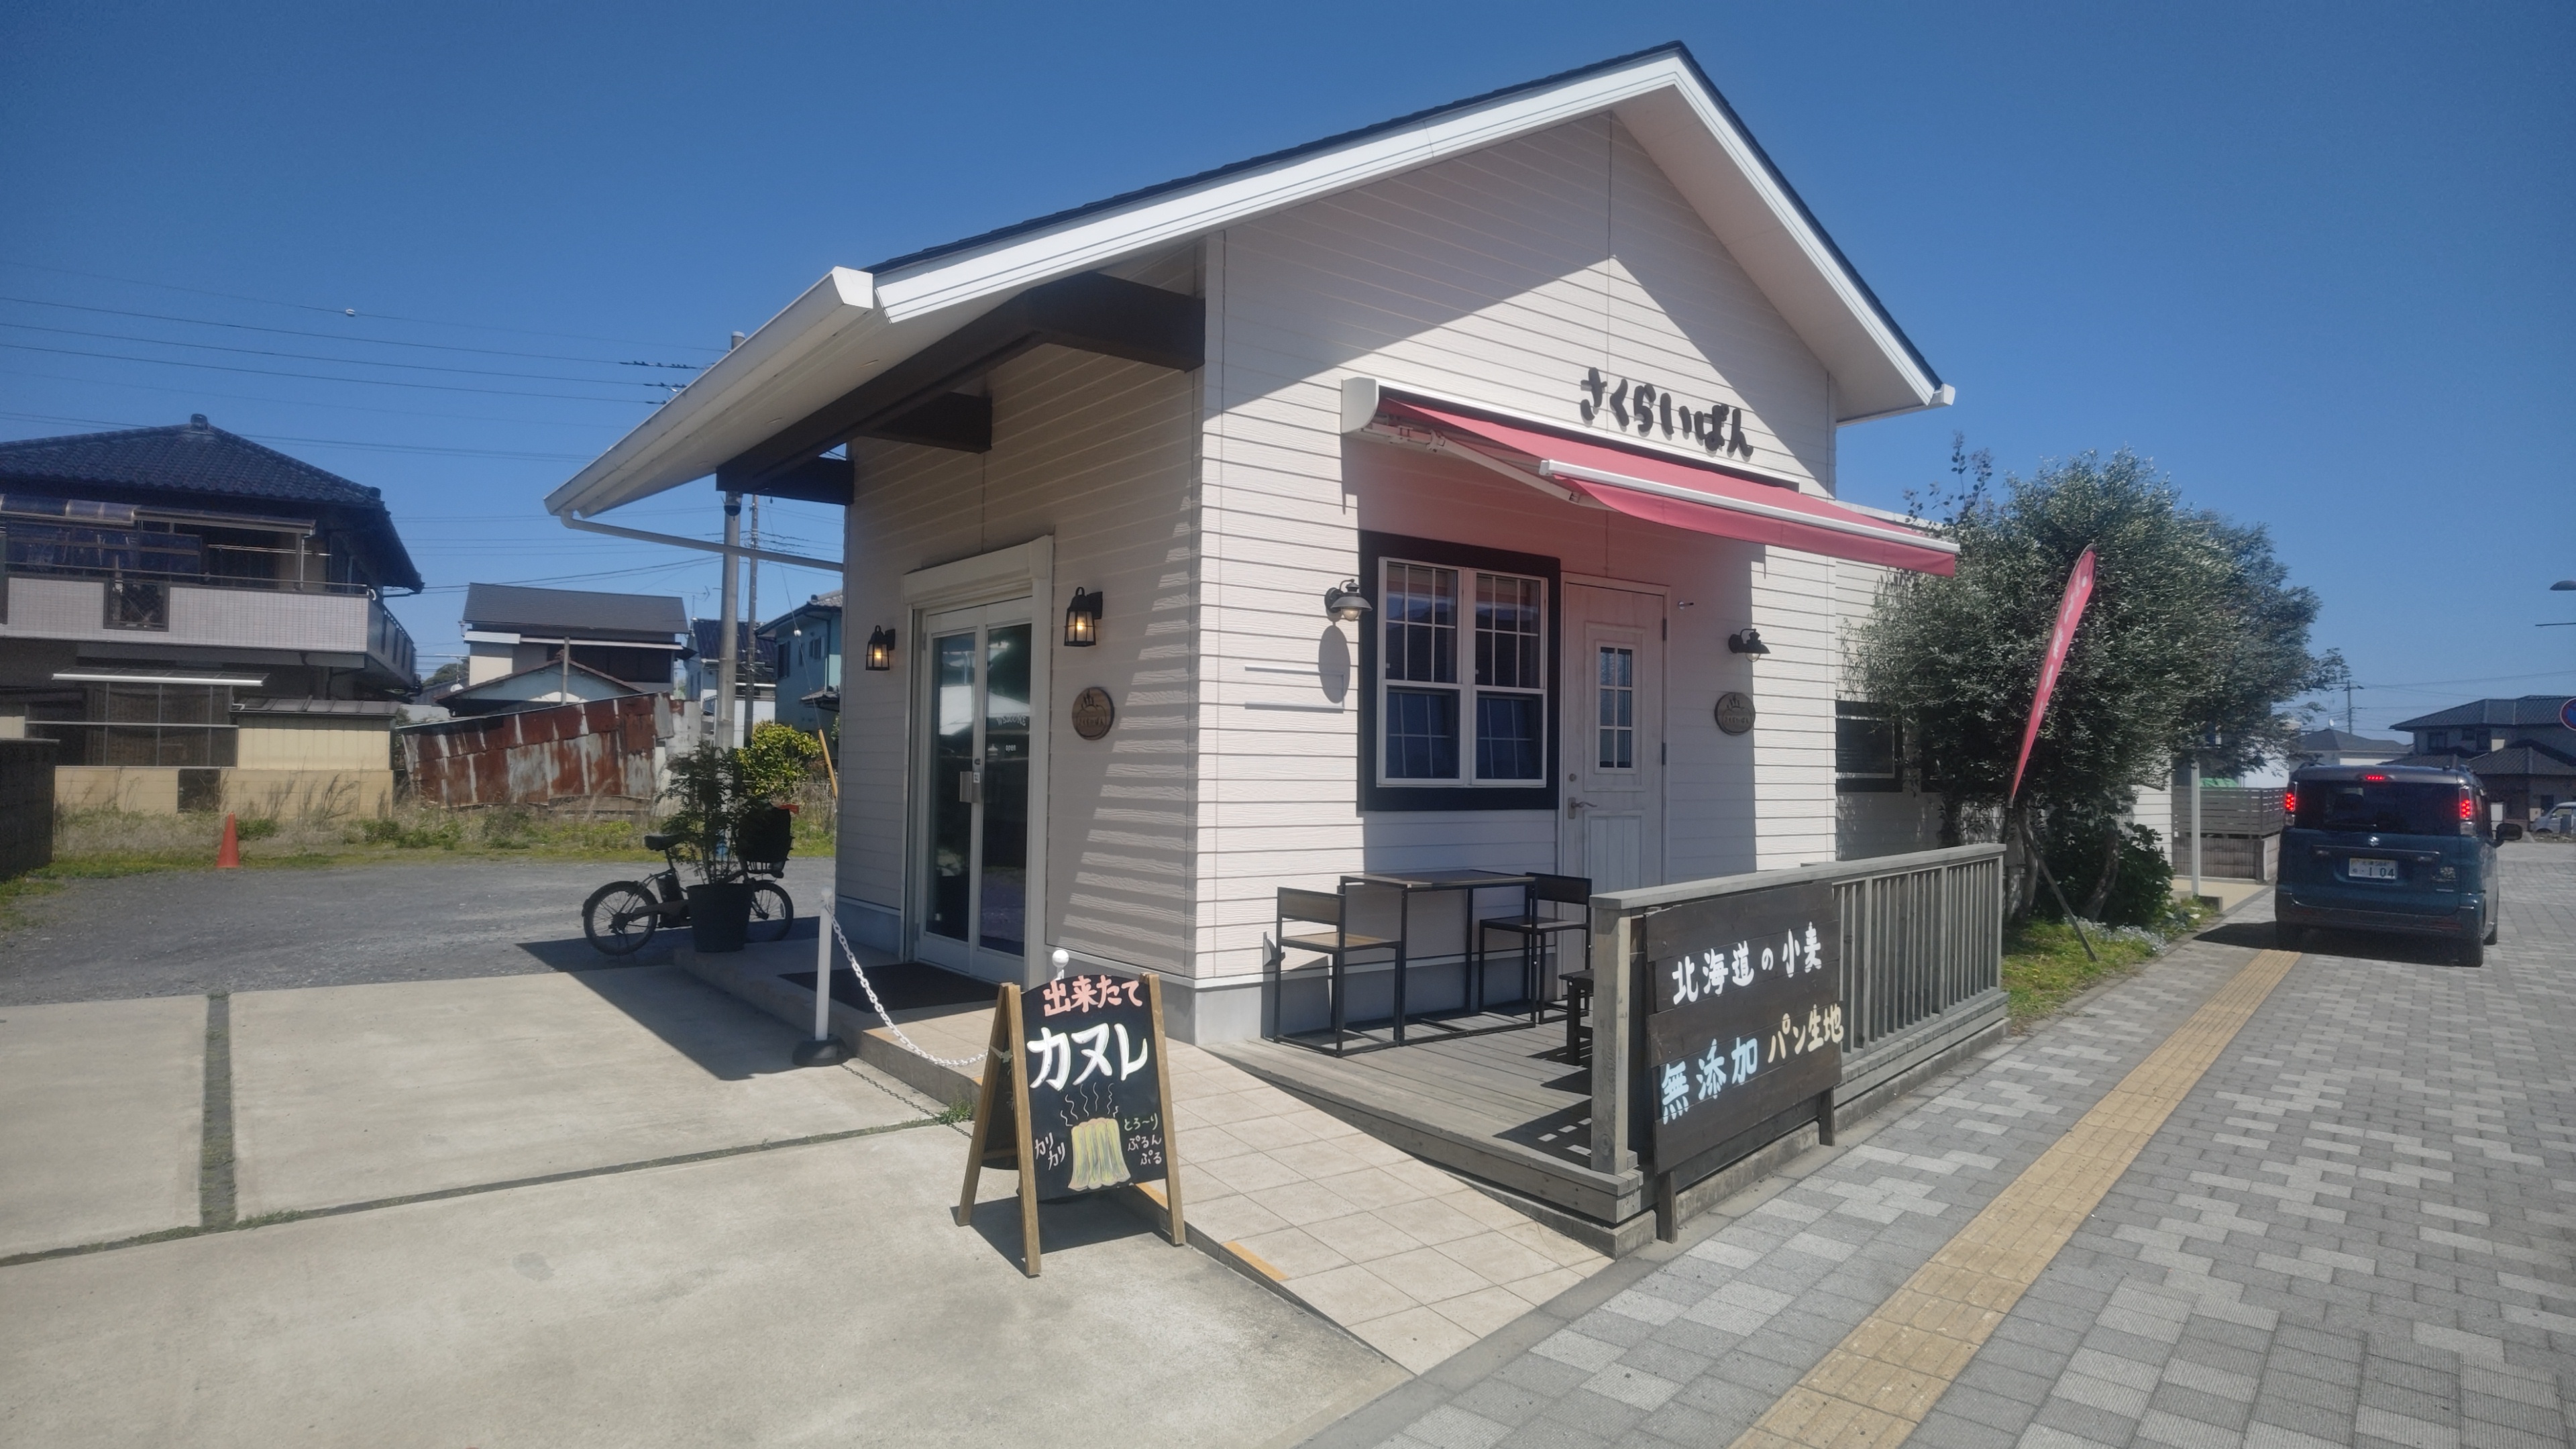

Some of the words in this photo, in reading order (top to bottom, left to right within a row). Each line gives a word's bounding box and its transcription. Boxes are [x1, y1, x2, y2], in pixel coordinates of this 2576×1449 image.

[1580, 366, 1754, 459] さくらいぱん
[1043, 975, 1143, 1016] 出来たて
[1672, 921, 1822, 1005] 北海道の小麦
[1026, 1022, 1148, 1091] カヌレ
